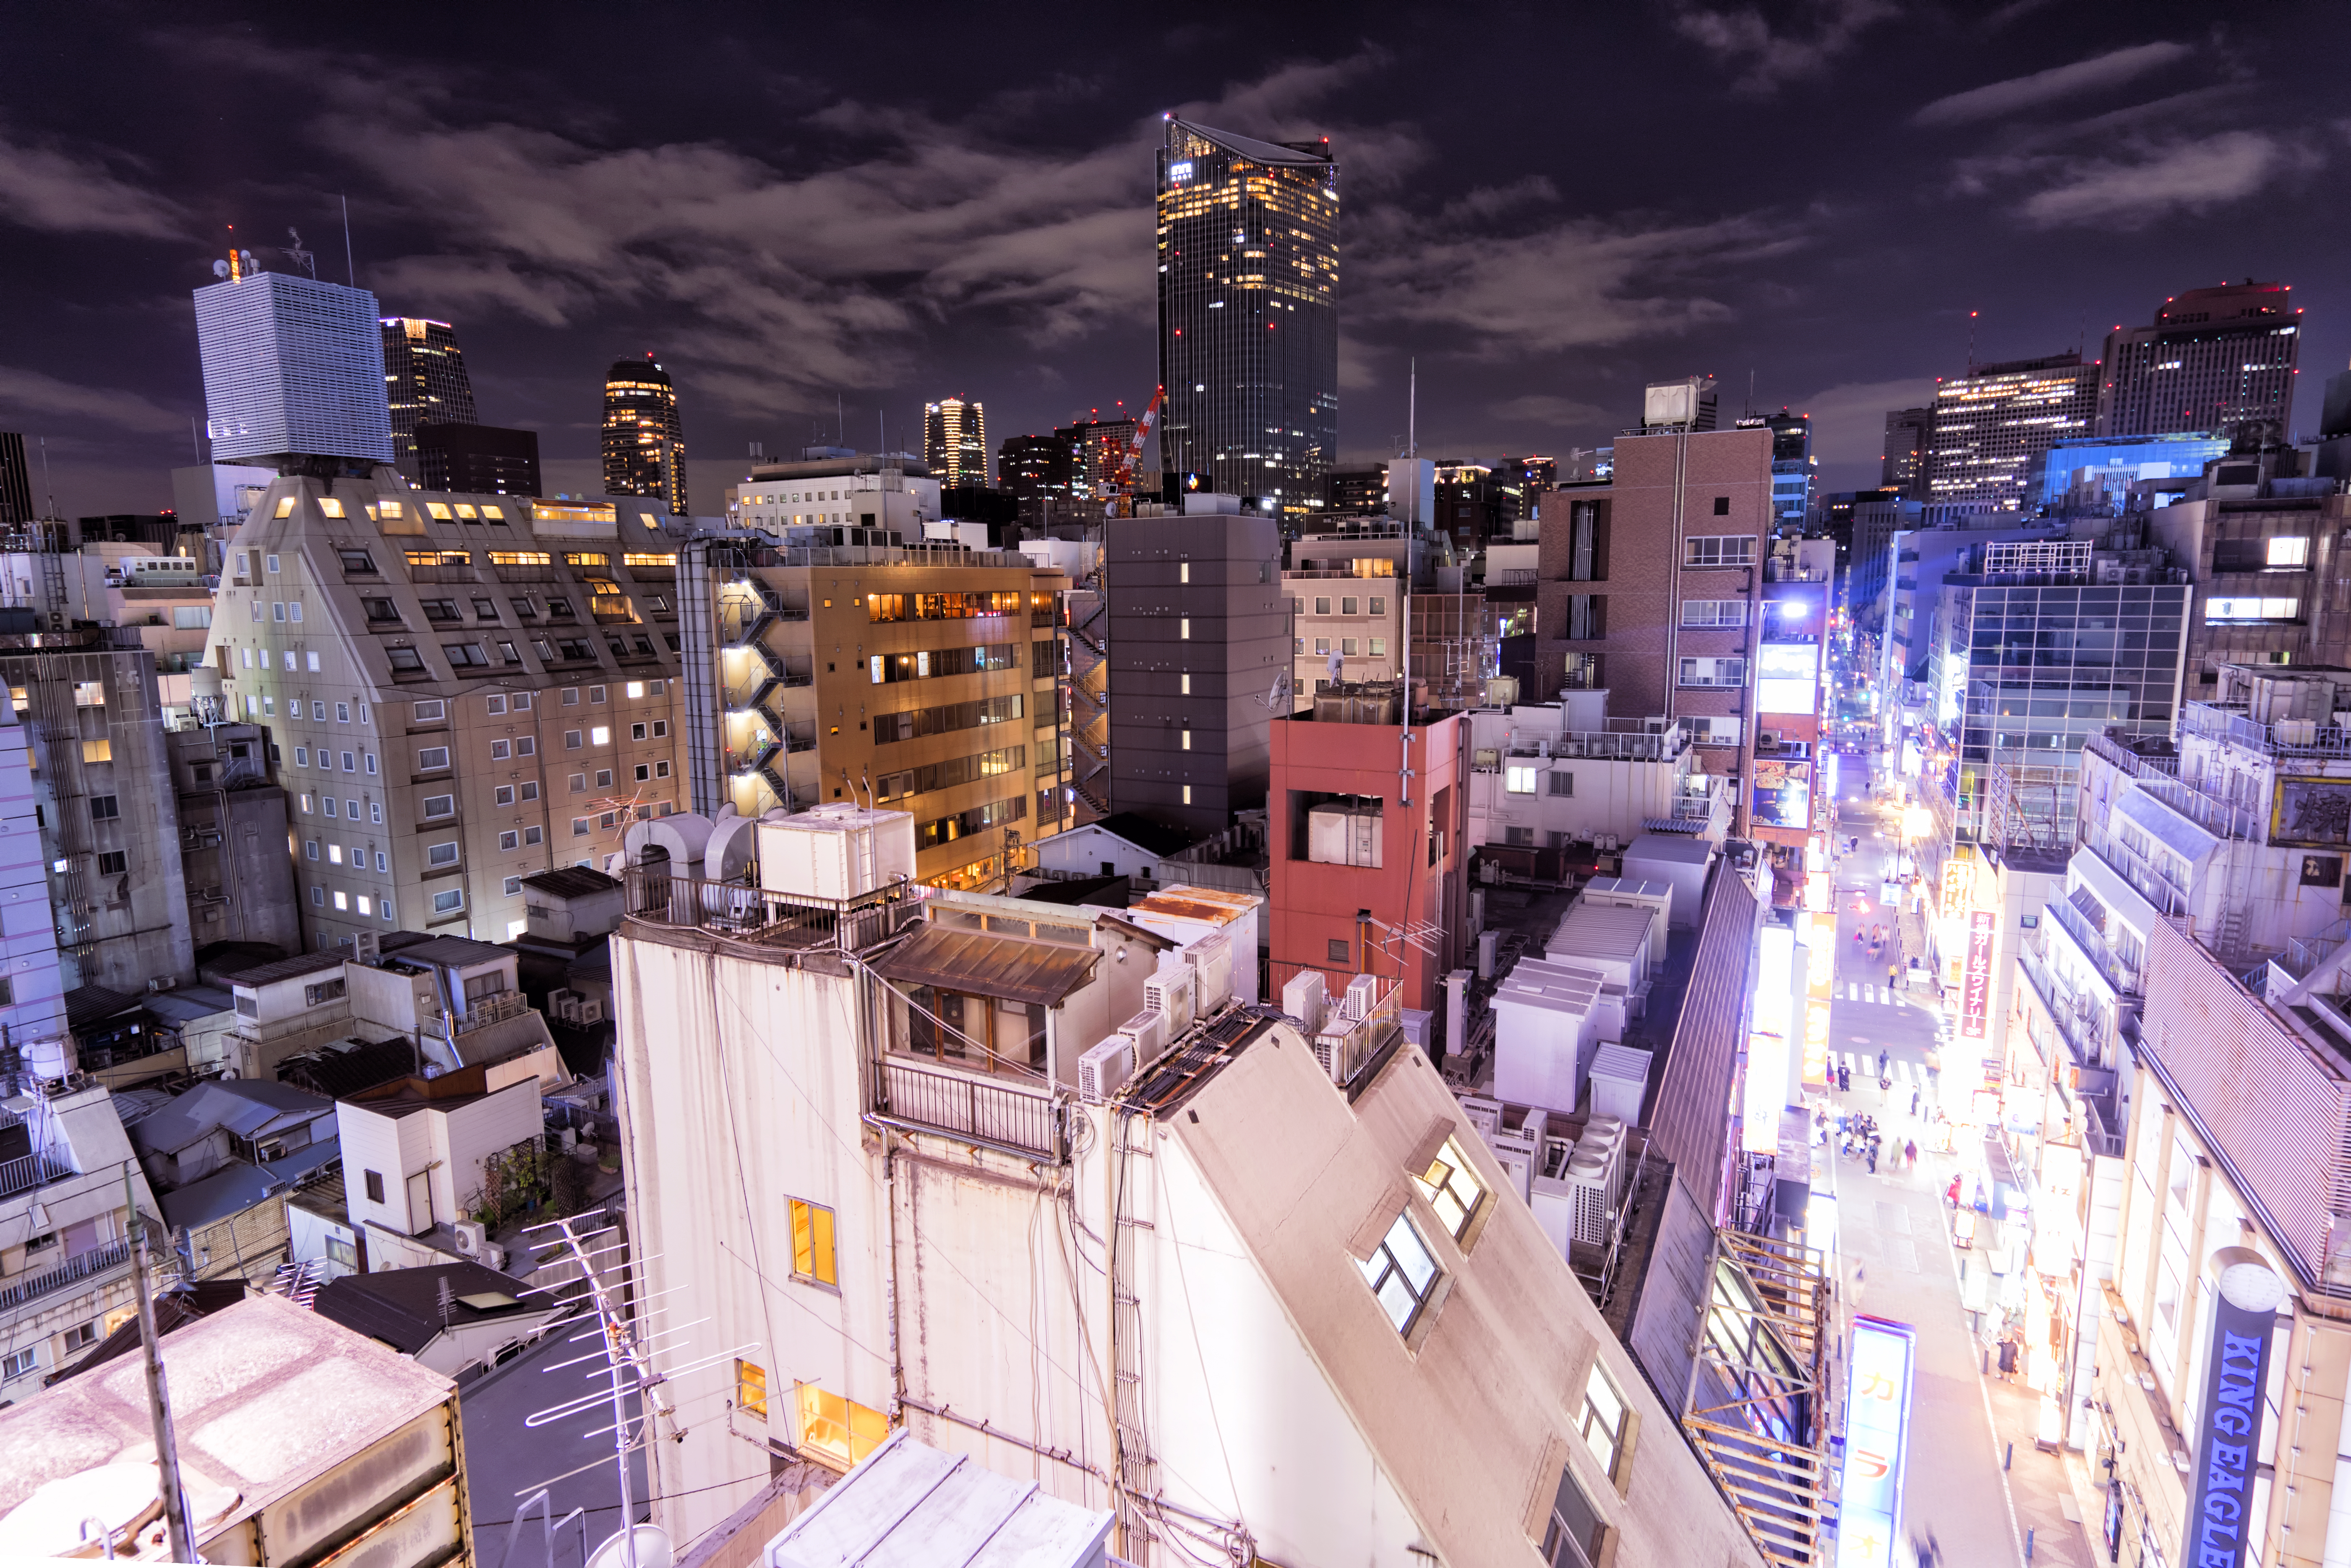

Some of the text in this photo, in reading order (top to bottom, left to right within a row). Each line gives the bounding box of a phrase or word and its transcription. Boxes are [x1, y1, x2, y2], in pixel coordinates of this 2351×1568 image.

[1944, 865, 1957, 912] ハイボール
[1954, 865, 1968, 912] ガールズ
[1966, 1027, 1981, 1036] 3F
[1848, 1371, 1895, 1560] カラオ
[2199, 1330, 2262, 1568] KING EAGLE
